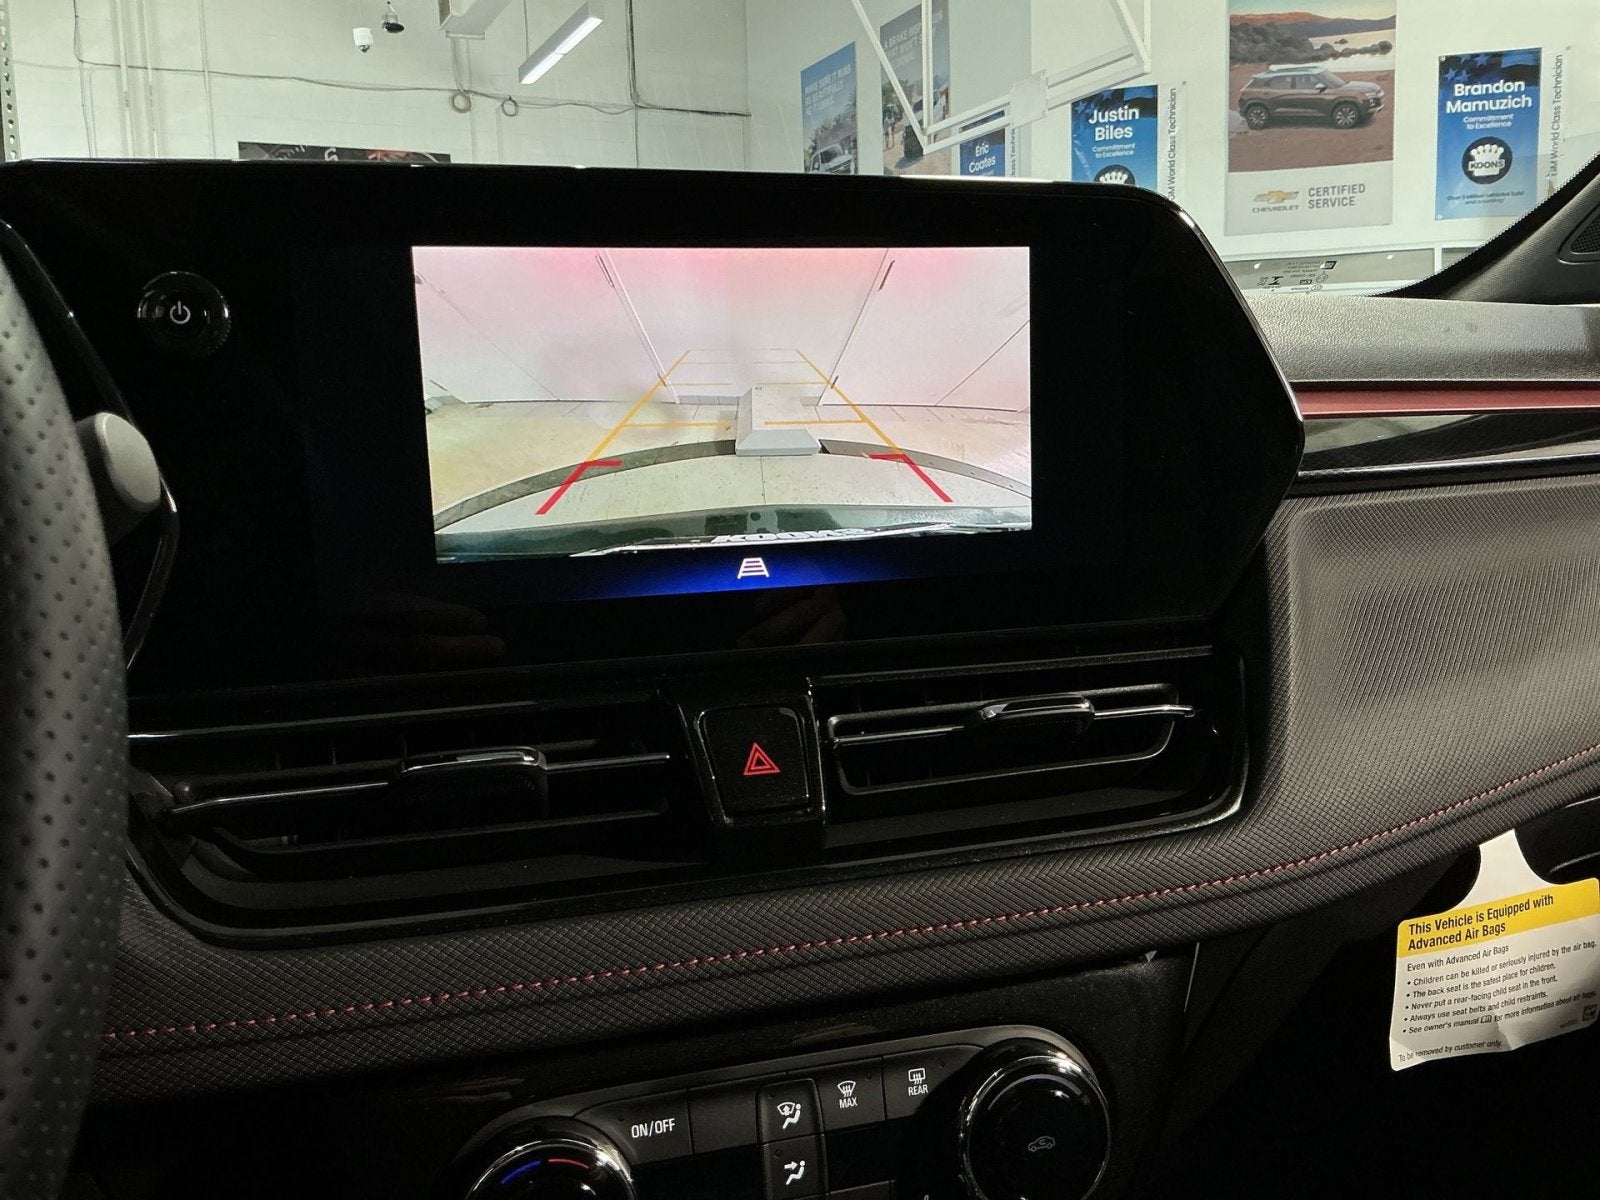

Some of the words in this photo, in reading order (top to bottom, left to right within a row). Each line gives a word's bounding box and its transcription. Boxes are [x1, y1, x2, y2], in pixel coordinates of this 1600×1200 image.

[1453, 79, 1525, 97] Brandon
[1553, 54, 1563, 104] Technician
[1088, 105, 1139, 124] Justin
[1168, 88, 1176, 134] Technician
[1446, 95, 1532, 114] Mamuzich
[1463, 113, 1514, 123] Commitment
[1551, 106, 1561, 130] Class
[1095, 125, 1133, 141] Biles
[976, 143, 989, 157] Eric
[1168, 135, 1176, 158] Class
[1550, 132, 1560, 159] World
[969, 156, 996, 173] Coates
[1168, 160, 1176, 185] World
[1470, 160, 1504, 169] KOONS
[1308, 183, 1365, 198] CERTIFIED
[1252, 205, 1299, 213] CHEVROLET
[1308, 196, 1356, 209] SERVICE
[1409, 922, 1431, 935] This
[1435, 914, 1473, 931] Vehicle
[1476, 911, 1484, 923] is
[1487, 899, 1530, 920] Equipped
[1533, 894, 1554, 908] with
[1408, 931, 1461, 951] Advanced
[1465, 928, 1479, 940] Air
[1482, 922, 1506, 937] Bags
[1407, 963, 1425, 972] Even
[1427, 959, 1444, 968] with
[1446, 952, 1480, 965] Advanced
[1482, 949, 1492, 958] Air
[1493, 945, 1509, 955] Bags
[1413, 975, 1444, 986] Children
[1471, 965, 1489, 976] killed
[1499, 955, 1527, 969] seriously
[1528, 950, 1550, 961] injured
[1552, 948, 1559, 957] by
[1561, 946, 1571, 954] the
[1573, 943, 1581, 951] air
[1583, 941, 1597, 949] bag.
[1412, 990, 1426, 998] The
[1427, 987, 1444, 996] back
[1446, 984, 1461, 993] seat
[1463, 982, 1469, 990] is
[1471, 980, 1481, 989] the
[1483, 975, 1501, 986] safest
[1502, 971, 1518, 983] place
[1520, 968, 1528, 976] for
[1529, 963, 1556, 974] children.
[1411, 1001, 1433, 1010] Never
[1434, 999, 1446, 1008] put
[1453, 992, 1491, 1004] rear-facing
[1493, 986, 1507, 997] child
[1508, 983, 1521, 993] seat
[1523, 981, 1528, 989] in
[1529, 980, 1540, 988] the
[1541, 975, 1558, 984] front.
[1409, 1012, 1435, 1022] Always
[1452, 1008, 1467, 1016] seat
[1469, 1005, 1486, 1014] belts
[1487, 1002, 1500, 1011] and
[1501, 997, 1515, 1008] child
[1516, 991, 1548, 1003] restraints.
[1408, 1026, 1422, 1034] See
[1424, 1021, 1452, 1031] owner's
[1453, 1017, 1479, 1027] manual
[1494, 1014, 1503, 1022] for
[1504, 1011, 1519, 1019] more
[1521, 1002, 1554, 1015] information
[1398, 1054, 1405, 1062] To
[1407, 1052, 1413, 1060] be
[1415, 1046, 1443, 1057] removed
[1454, 1041, 1485, 1051] customer
[1486, 1040, 1502, 1048] only.
[908, 1083, 929, 1096] REAR
[839, 1097, 858, 1108] MAX
[631, 1117, 676, 1138] ON/OFF
